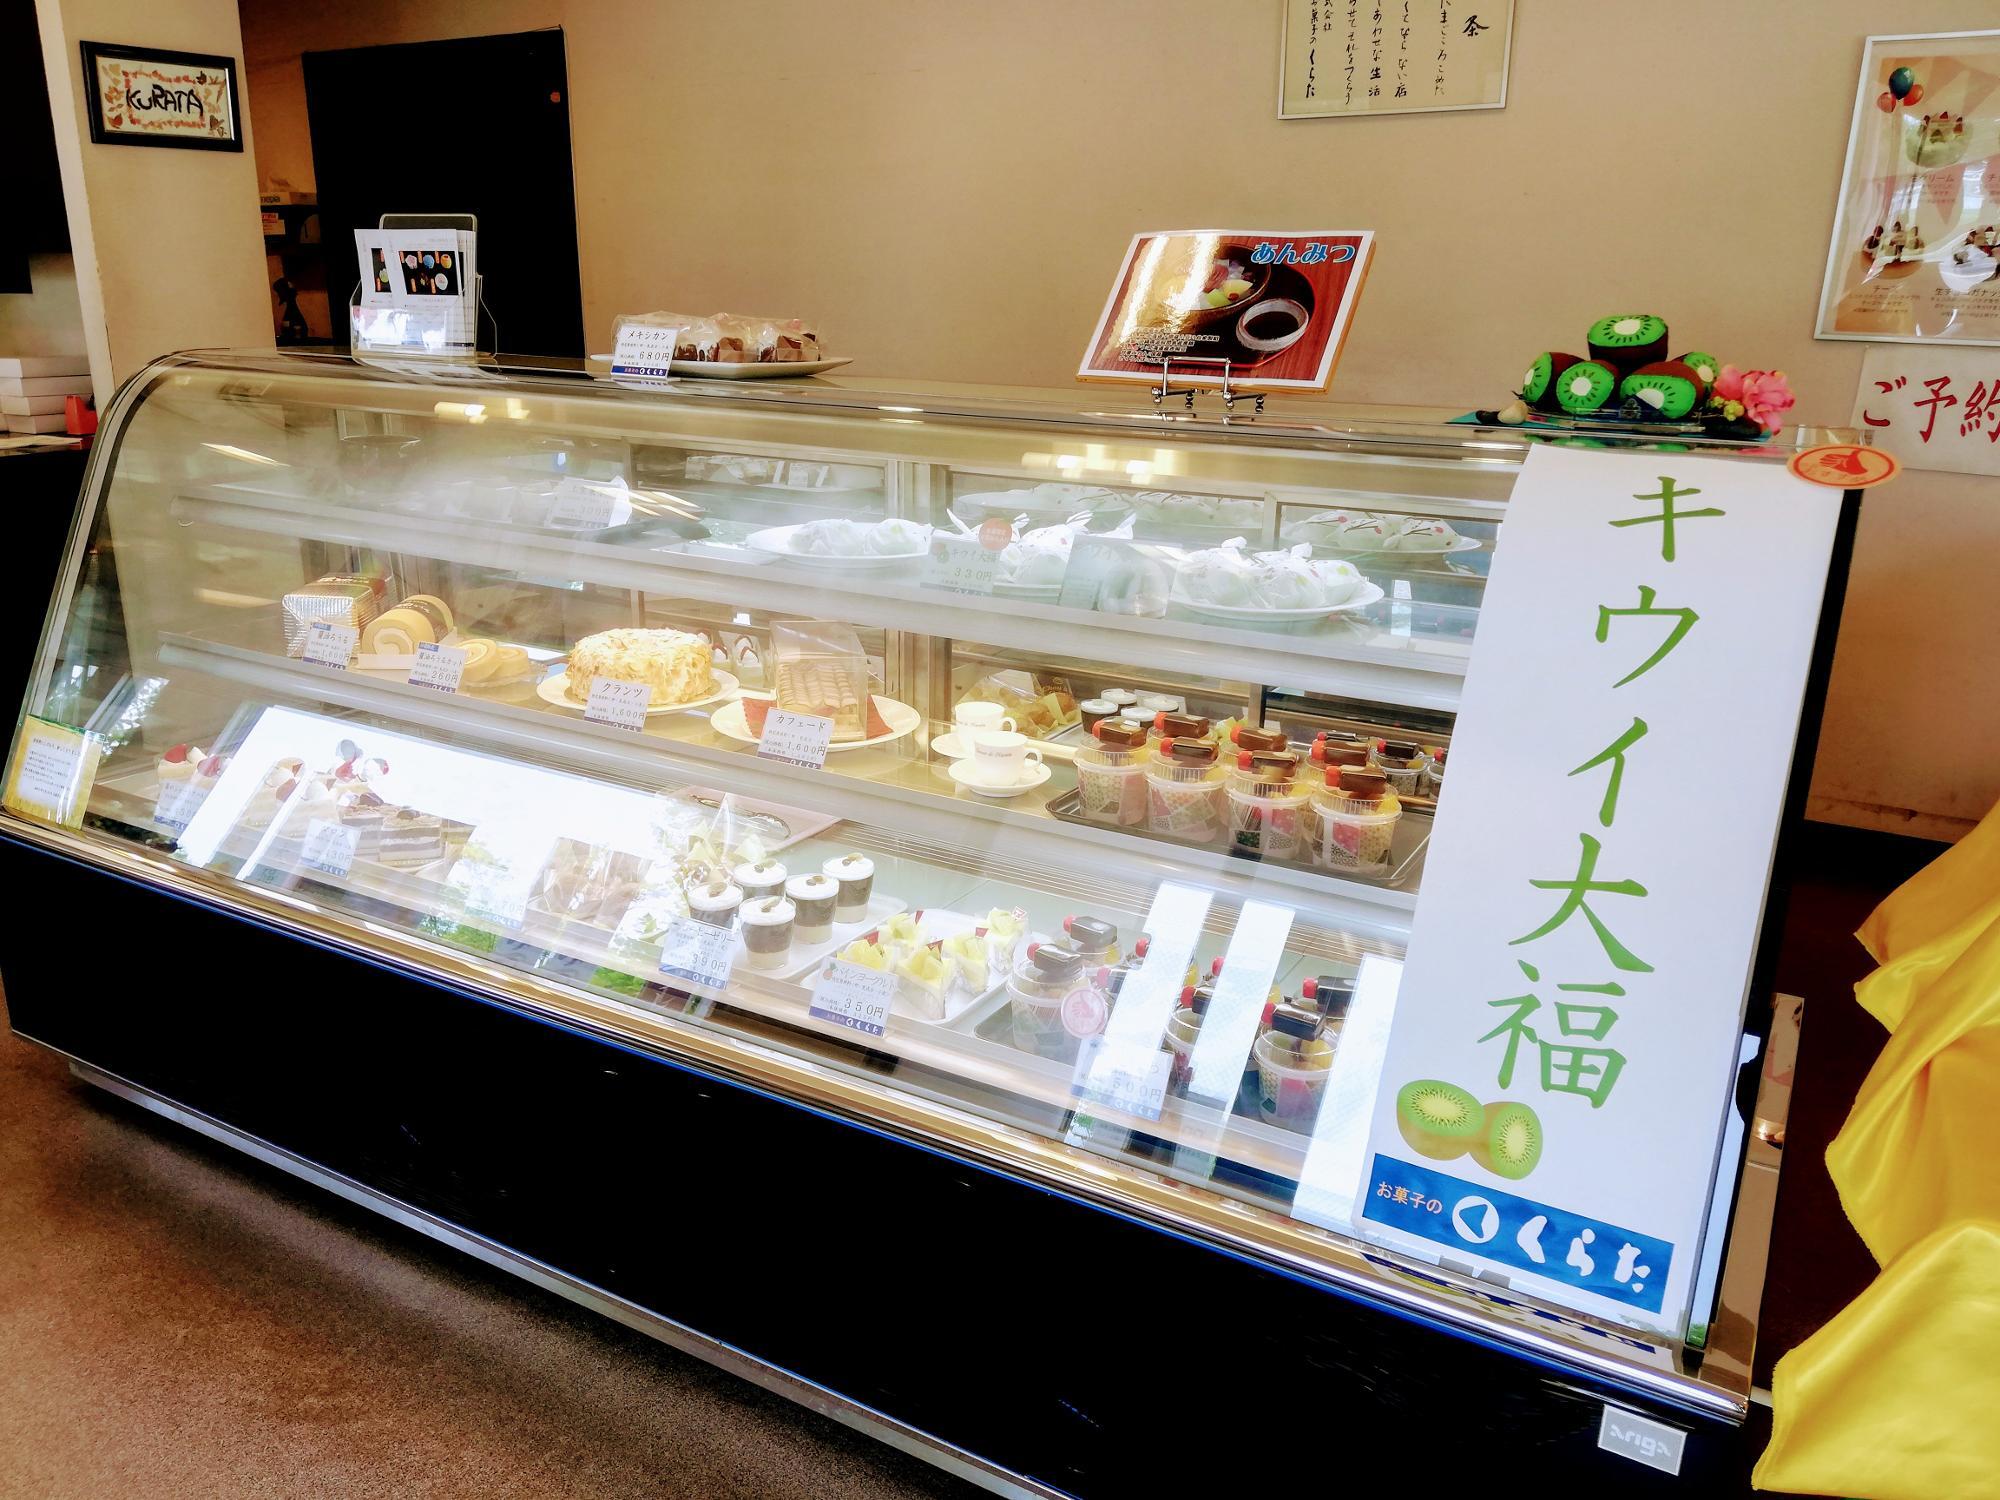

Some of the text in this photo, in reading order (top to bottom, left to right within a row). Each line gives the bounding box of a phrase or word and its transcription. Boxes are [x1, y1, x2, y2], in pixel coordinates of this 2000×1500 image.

[1250, 242, 1356, 265] あんみつ
[627, 329, 669, 341] メキシカン
[639, 350, 670, 362] 680円
[1863, 375, 2000, 444] ご予約
[430, 670, 459, 684] 260円
[600, 681, 643, 698] クランツ
[1476, 475, 1727, 1110] キウイ大福
[844, 997, 884, 1019] 350円
[1376, 1181, 1443, 1215] お菓子の
